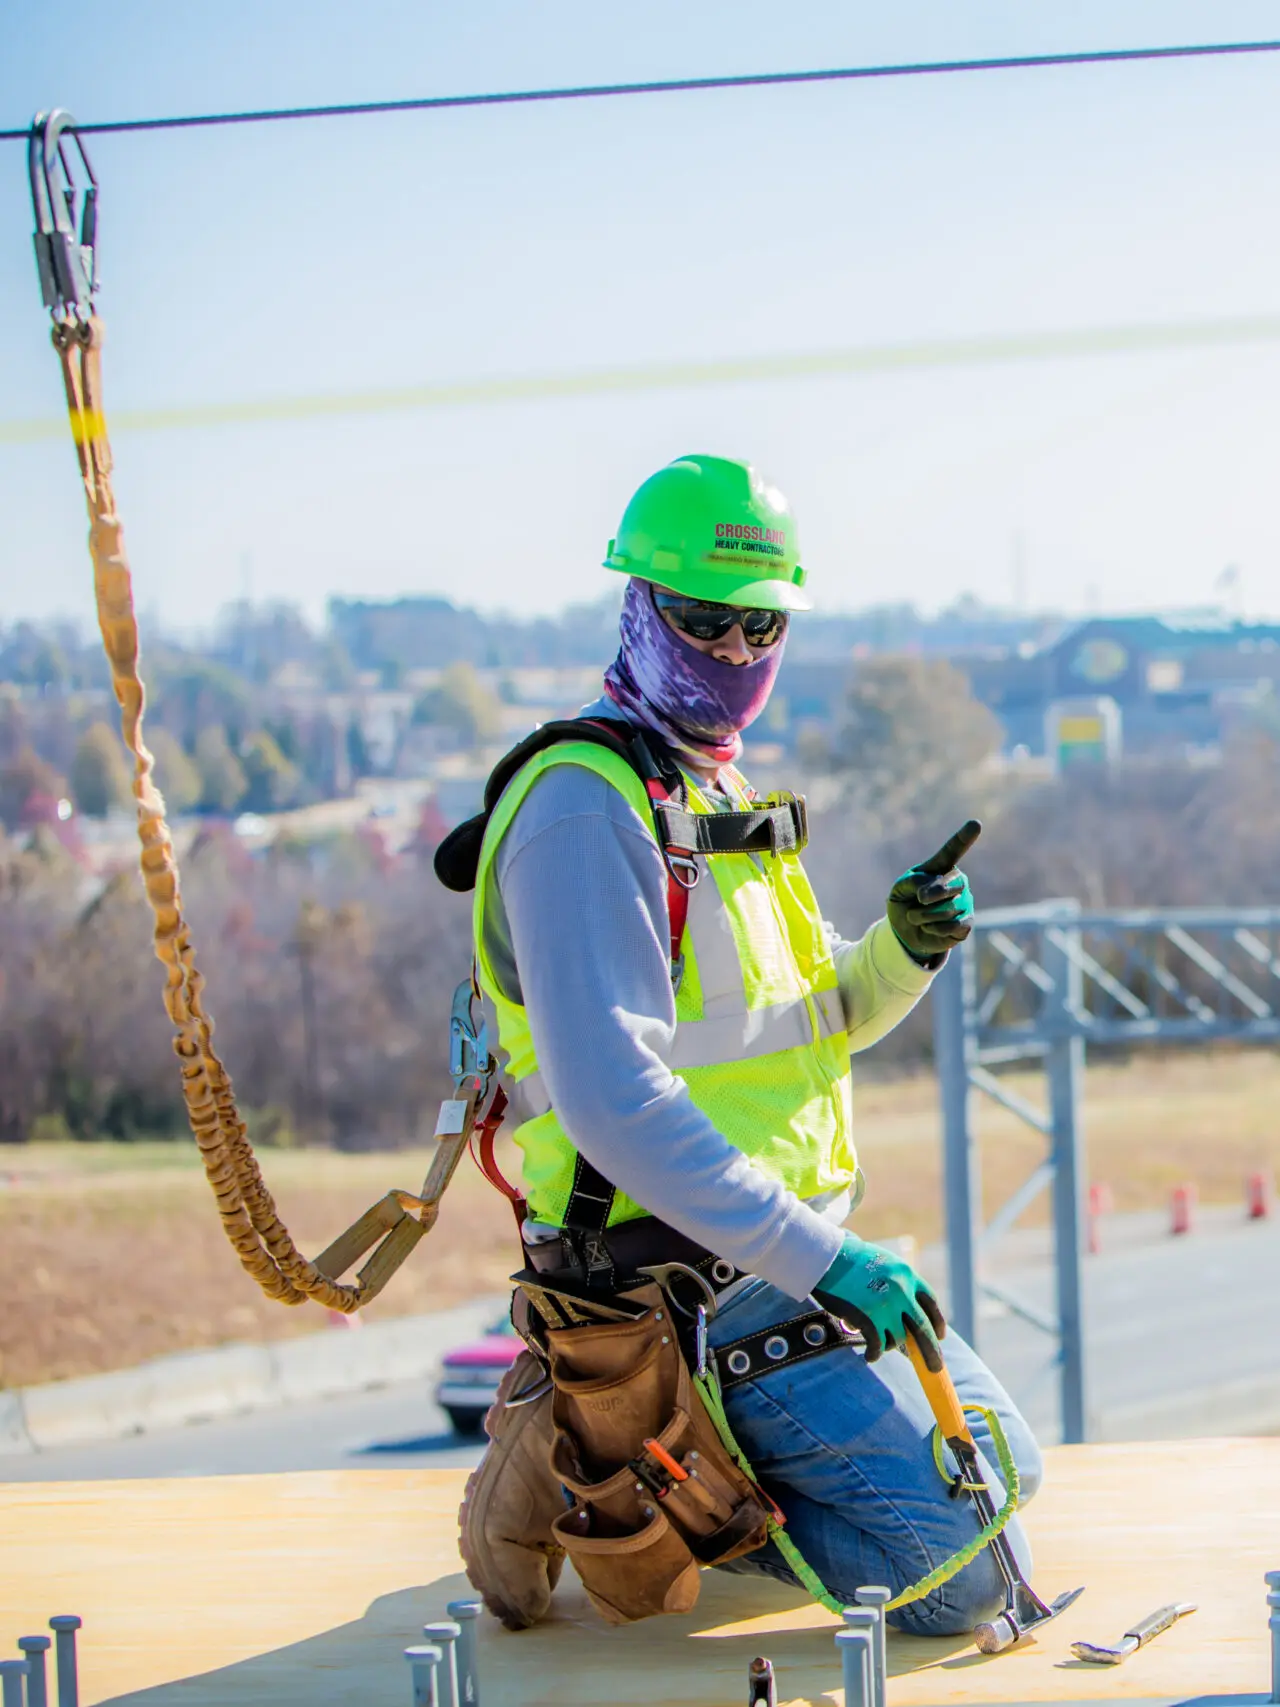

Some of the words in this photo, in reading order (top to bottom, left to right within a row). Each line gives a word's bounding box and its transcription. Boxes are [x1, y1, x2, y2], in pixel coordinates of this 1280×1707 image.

[715, 523, 785, 544] CROSSLAND
[715, 539, 740, 550] HEAVY
[741, 541, 785, 556] CONTRACTORS
